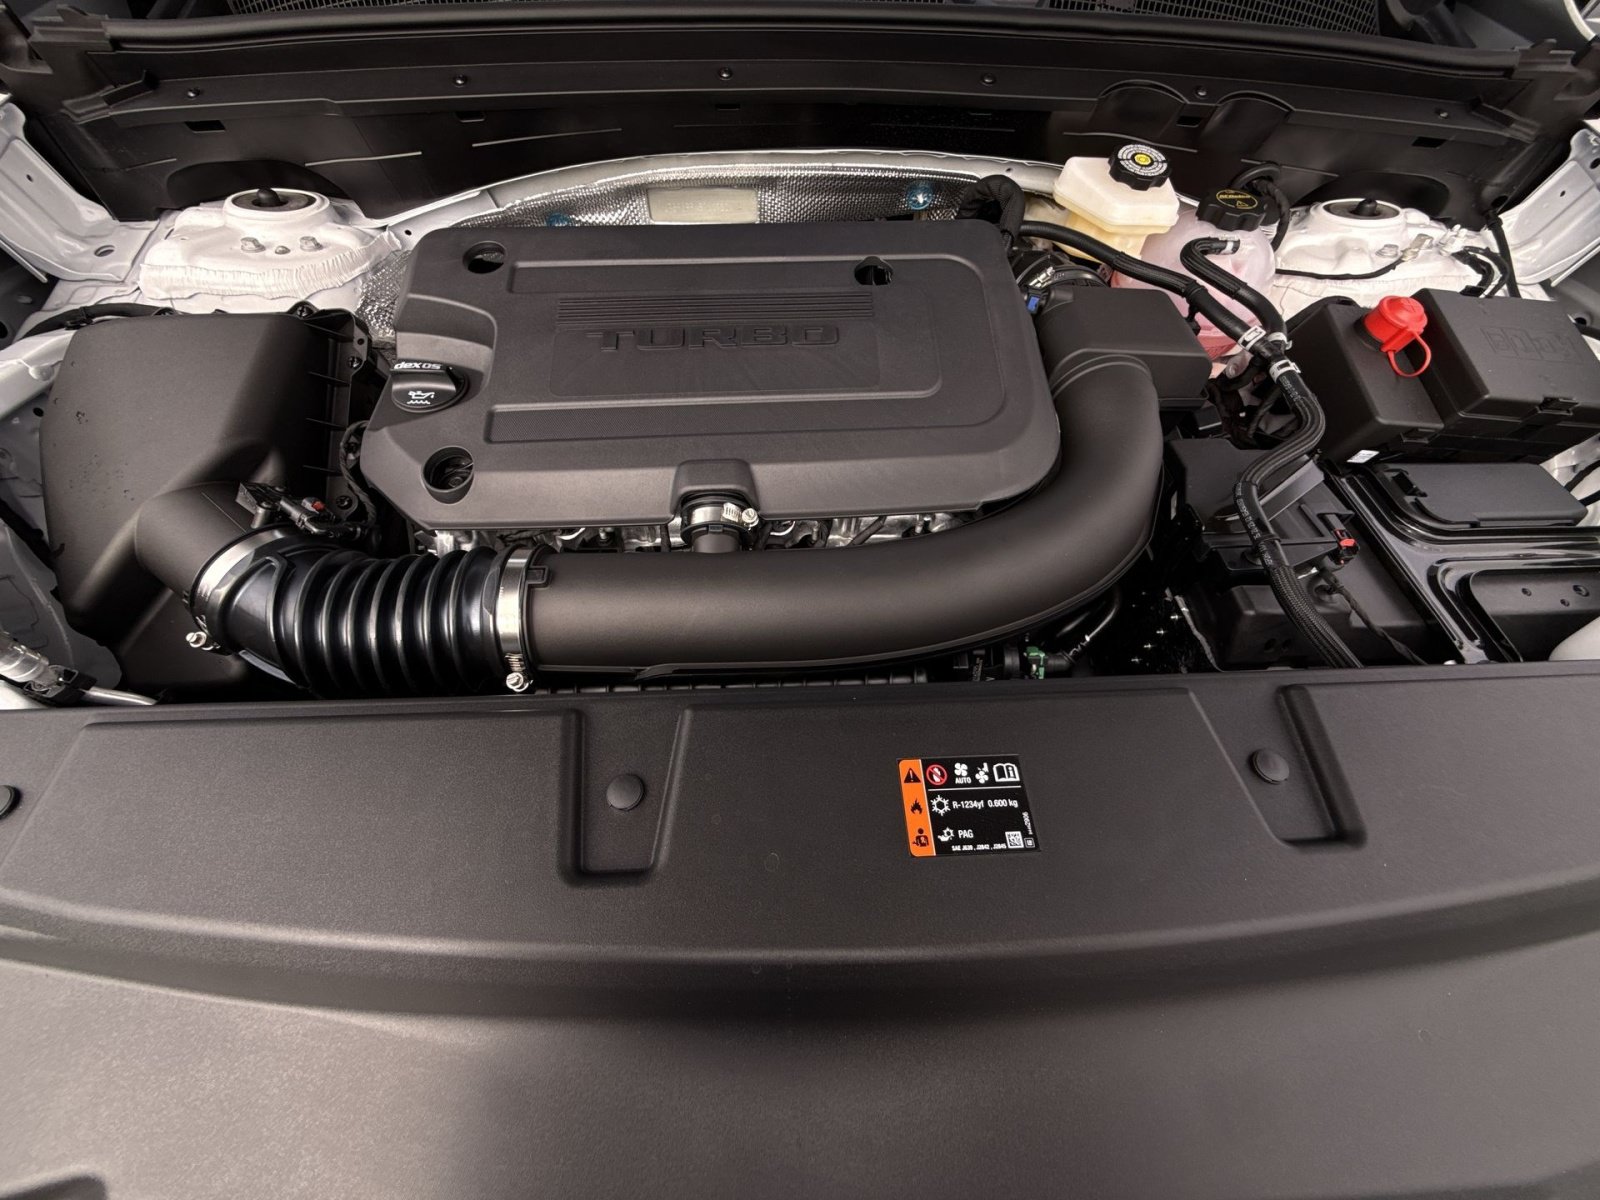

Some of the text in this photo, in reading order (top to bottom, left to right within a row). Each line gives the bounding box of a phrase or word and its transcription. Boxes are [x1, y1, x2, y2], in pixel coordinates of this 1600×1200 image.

[587, 325, 839, 352] TURBO
[393, 361, 442, 369] dexos
[952, 799, 1018, 809] R-1234yf 0.600 kg
[957, 829, 974, 838] PAG
